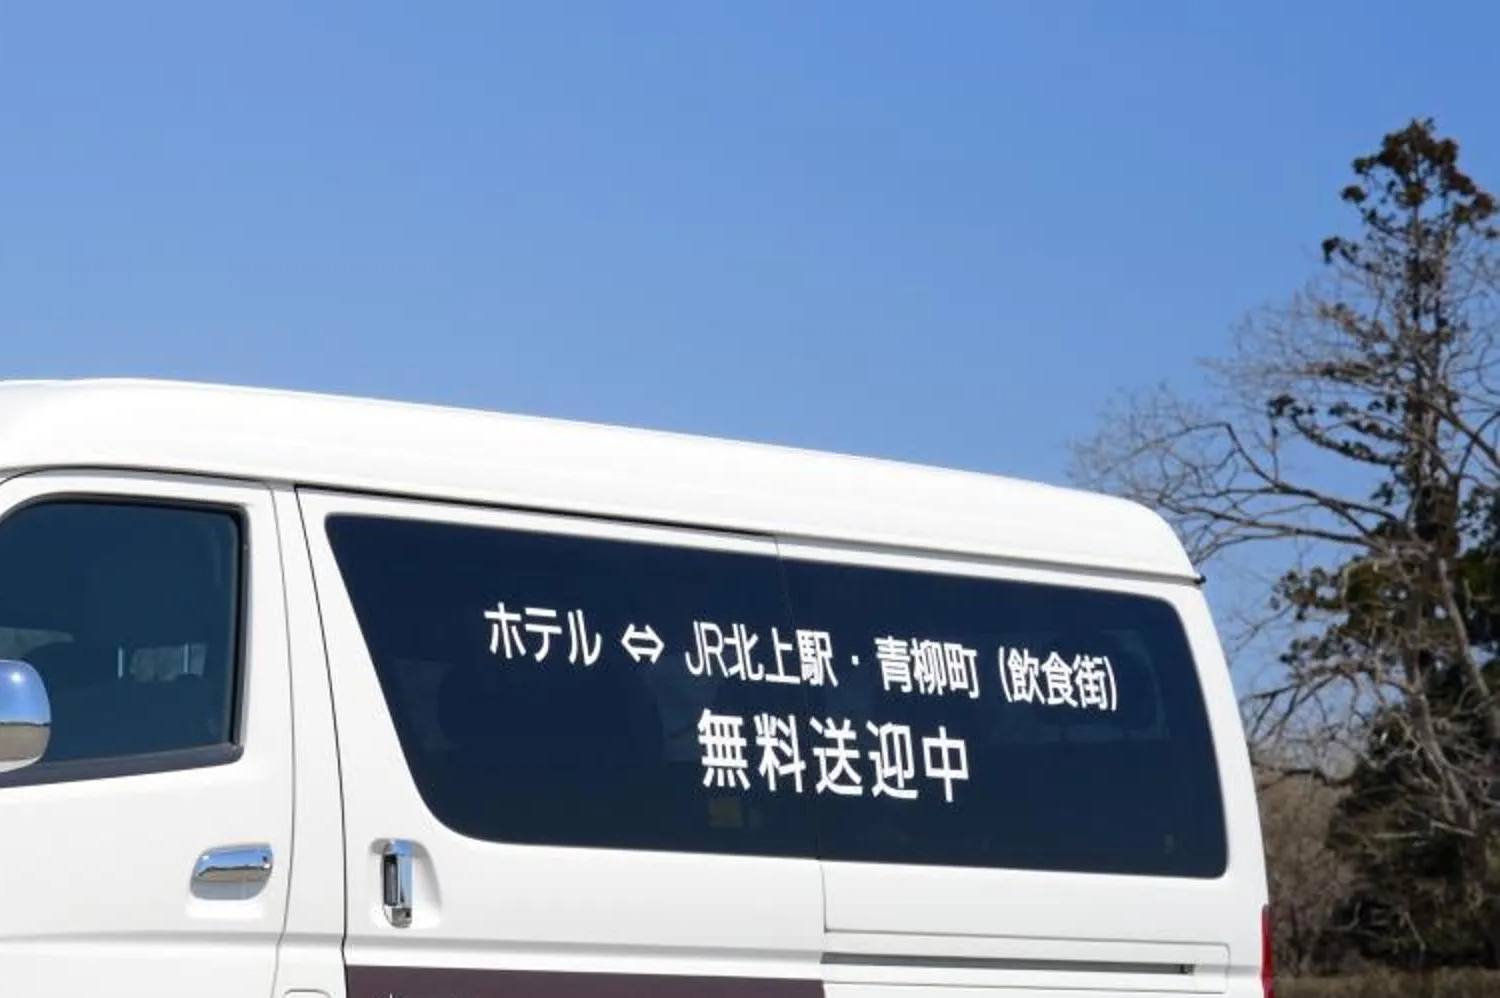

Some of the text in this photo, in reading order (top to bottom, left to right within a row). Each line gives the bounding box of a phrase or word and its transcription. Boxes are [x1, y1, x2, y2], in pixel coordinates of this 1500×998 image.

[483, 601, 602, 667] ホテル
[697, 707, 969, 803] 無料送迎中
